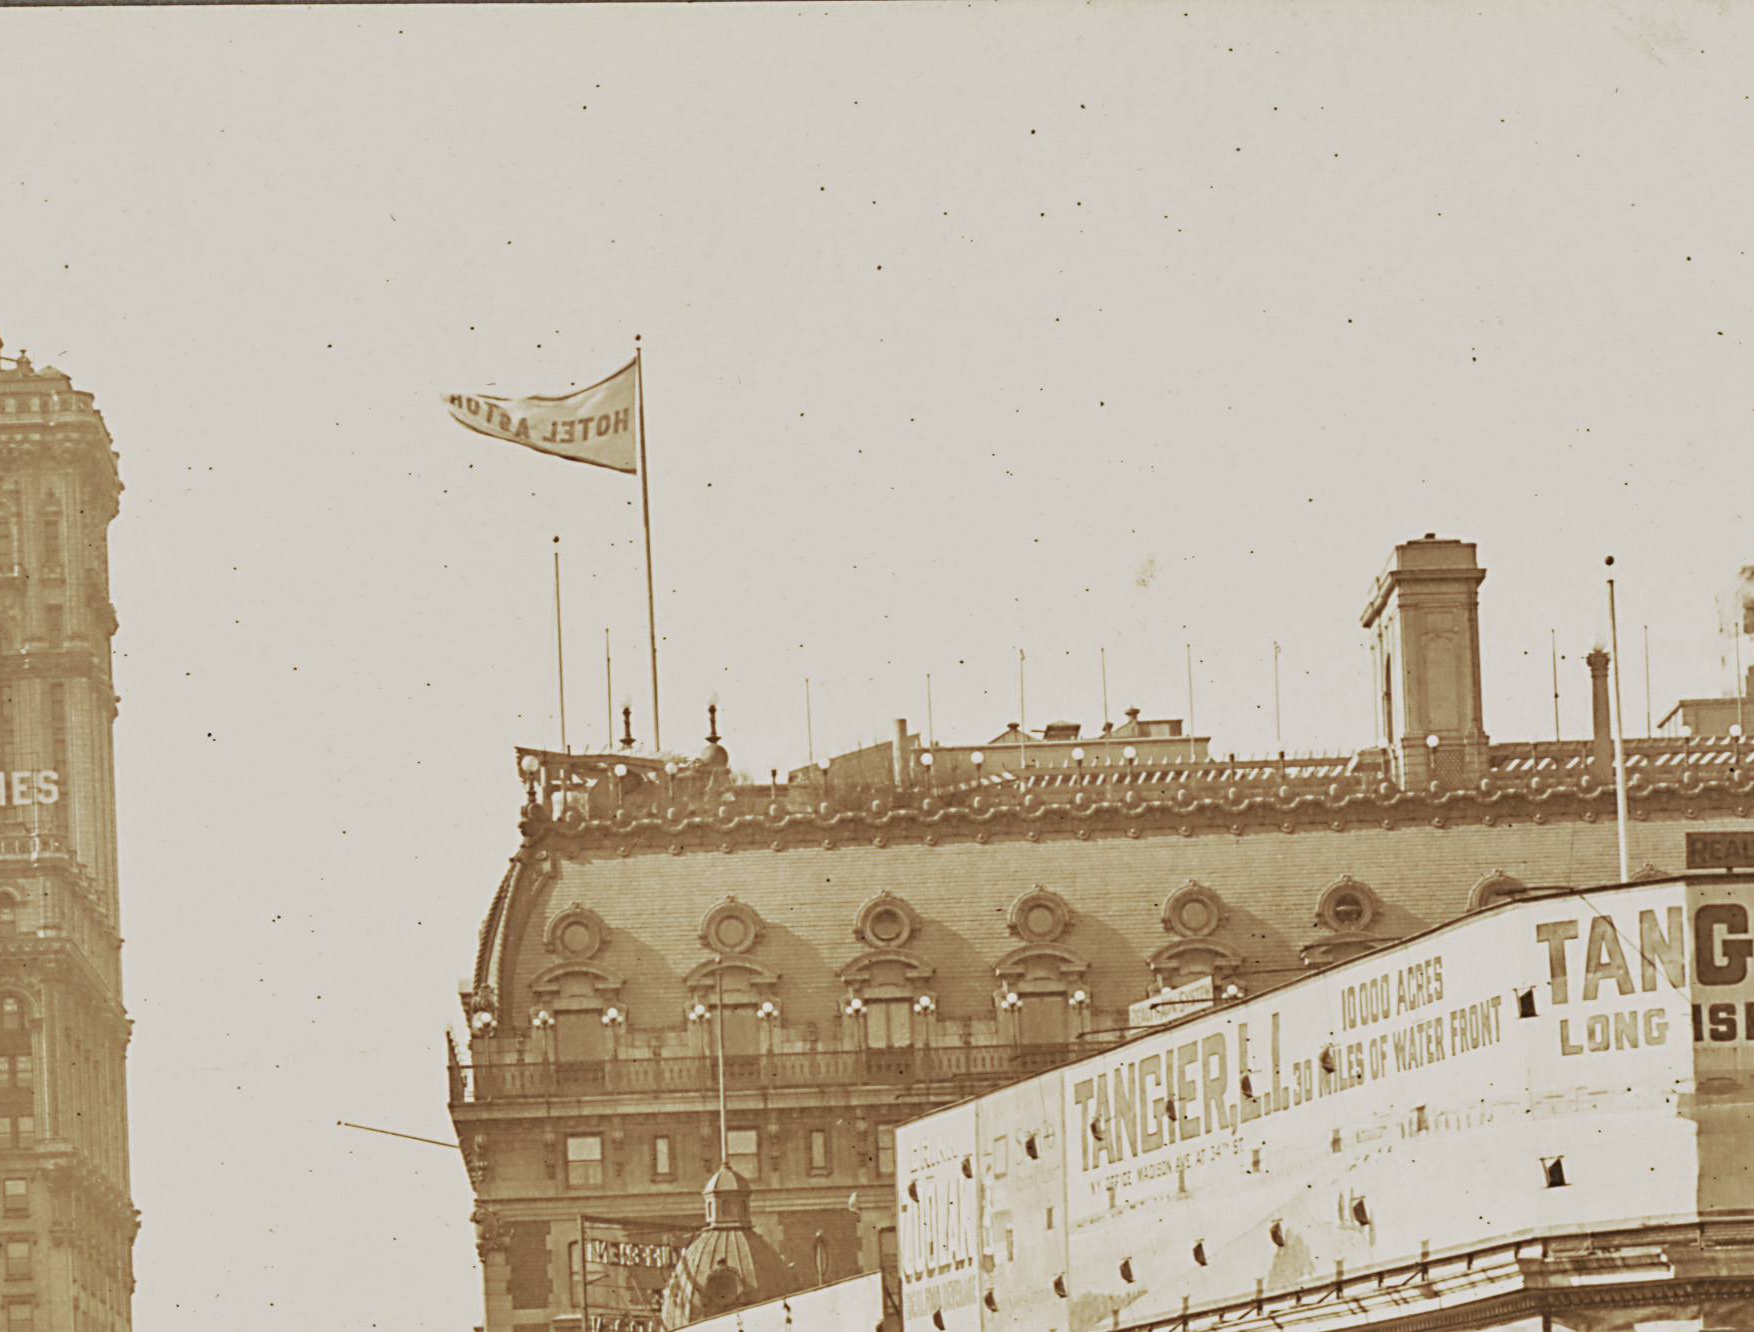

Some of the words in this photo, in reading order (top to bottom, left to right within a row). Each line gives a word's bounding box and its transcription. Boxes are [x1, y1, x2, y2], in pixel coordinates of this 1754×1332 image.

[1396, 956, 1444, 1018] ACRES
[1292, 1069, 1314, 1107] 30
[1371, 1039, 1389, 1082] OF
[1392, 1017, 1445, 1074] WATER
[1451, 995, 1503, 1058] FRONT
[1560, 1008, 1669, 1057] LONG
